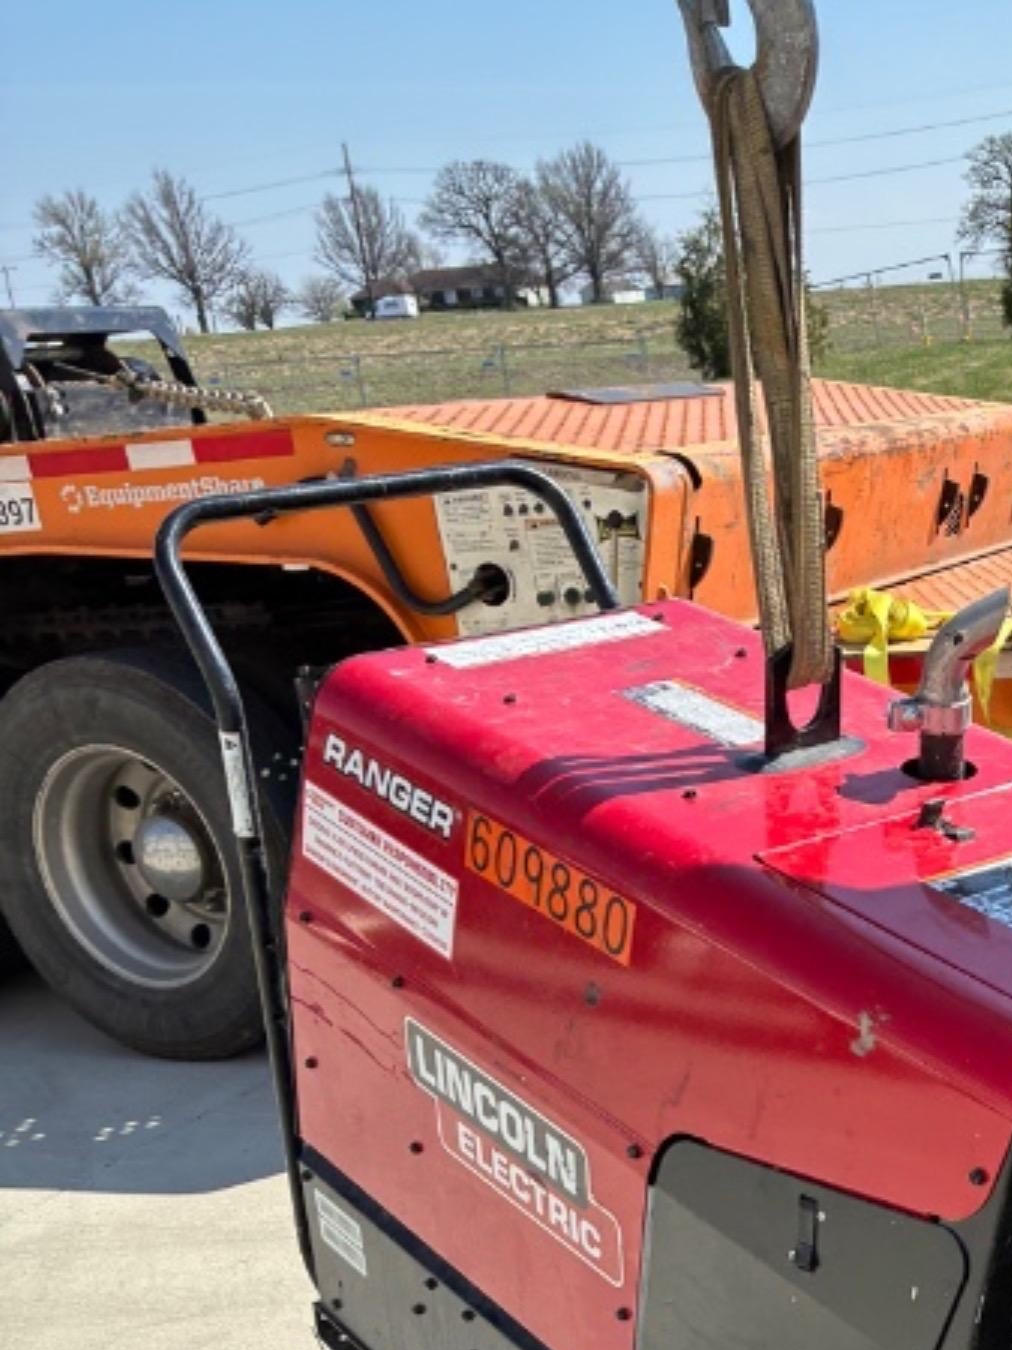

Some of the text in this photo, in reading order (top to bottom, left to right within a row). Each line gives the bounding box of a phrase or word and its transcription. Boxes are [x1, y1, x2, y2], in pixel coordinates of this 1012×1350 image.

[86, 477, 265, 507] EquipmentShare
[324, 734, 454, 837] RANGER
[471, 816, 628, 955] 609880
[415, 1034, 577, 1195] LINCOLN
[457, 1121, 602, 1259] ELECTRIC
